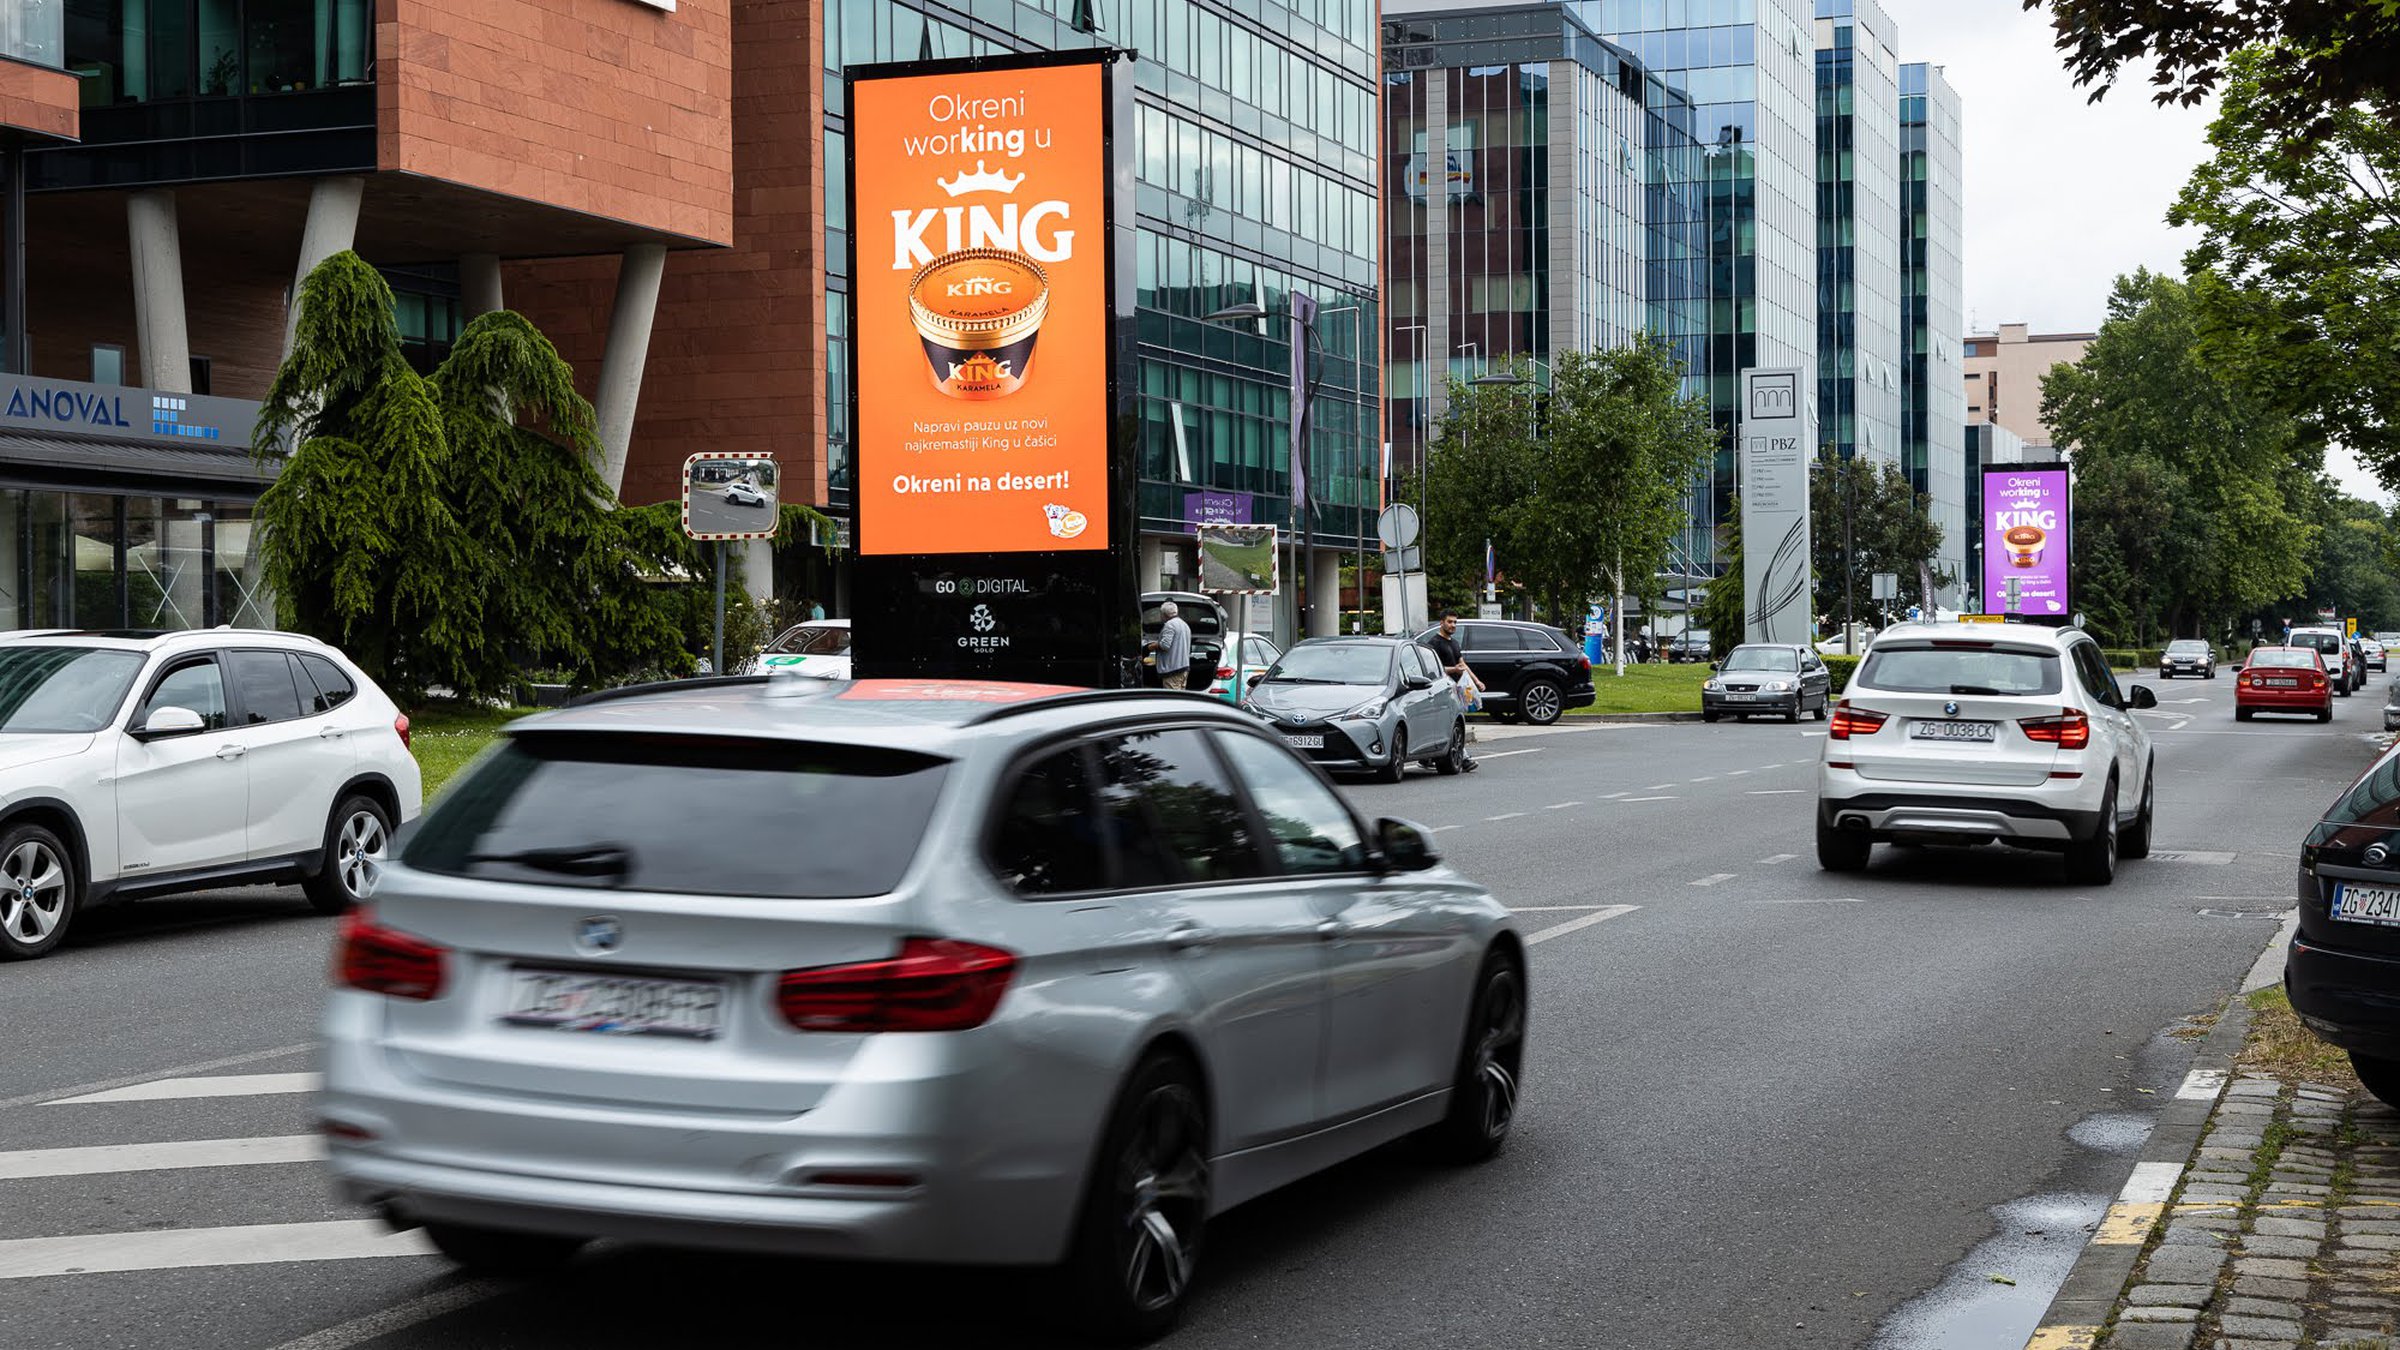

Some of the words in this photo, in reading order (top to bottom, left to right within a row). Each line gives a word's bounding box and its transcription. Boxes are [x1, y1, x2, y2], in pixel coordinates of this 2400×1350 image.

[929, 90, 1025, 122] Okreni
[904, 125, 1025, 157] working
[1035, 128, 1050, 148] u
[892, 200, 1075, 270] KING
[946, 281, 1012, 297] KING
[948, 306, 1010, 317] KARAMELA
[948, 359, 1012, 382] KING
[957, 383, 1001, 392] KARAMELA
[5, 385, 130, 427] ANOVAL
[913, 420, 961, 434] Napravi
[964, 420, 1001, 434] pauzu
[1004, 421, 1018, 431] uz
[1022, 417, 1048, 430] novi
[905, 437, 978, 454] najkremastiji
[982, 436, 1009, 451] King
[1013, 439, 1021, 448] u
[1025, 434, 1057, 447] čašici
[1771, 438, 1797, 451] PBZ
[893, 473, 961, 494] Okreni
[967, 478, 991, 491] na
[997, 470, 1070, 491] desert!
[2008, 477, 2041, 488] Okreni
[2000, 488, 2041, 499] working
[2043, 489, 2050, 497] u
[1995, 510, 2057, 531] KING
[935, 580, 956, 594] GO
[977, 579, 1030, 594] DIGITAL
[957, 637, 1010, 647] GREEN
[1920, 722, 1936, 735] ZG
[2342, 888, 2360, 914] ZG
